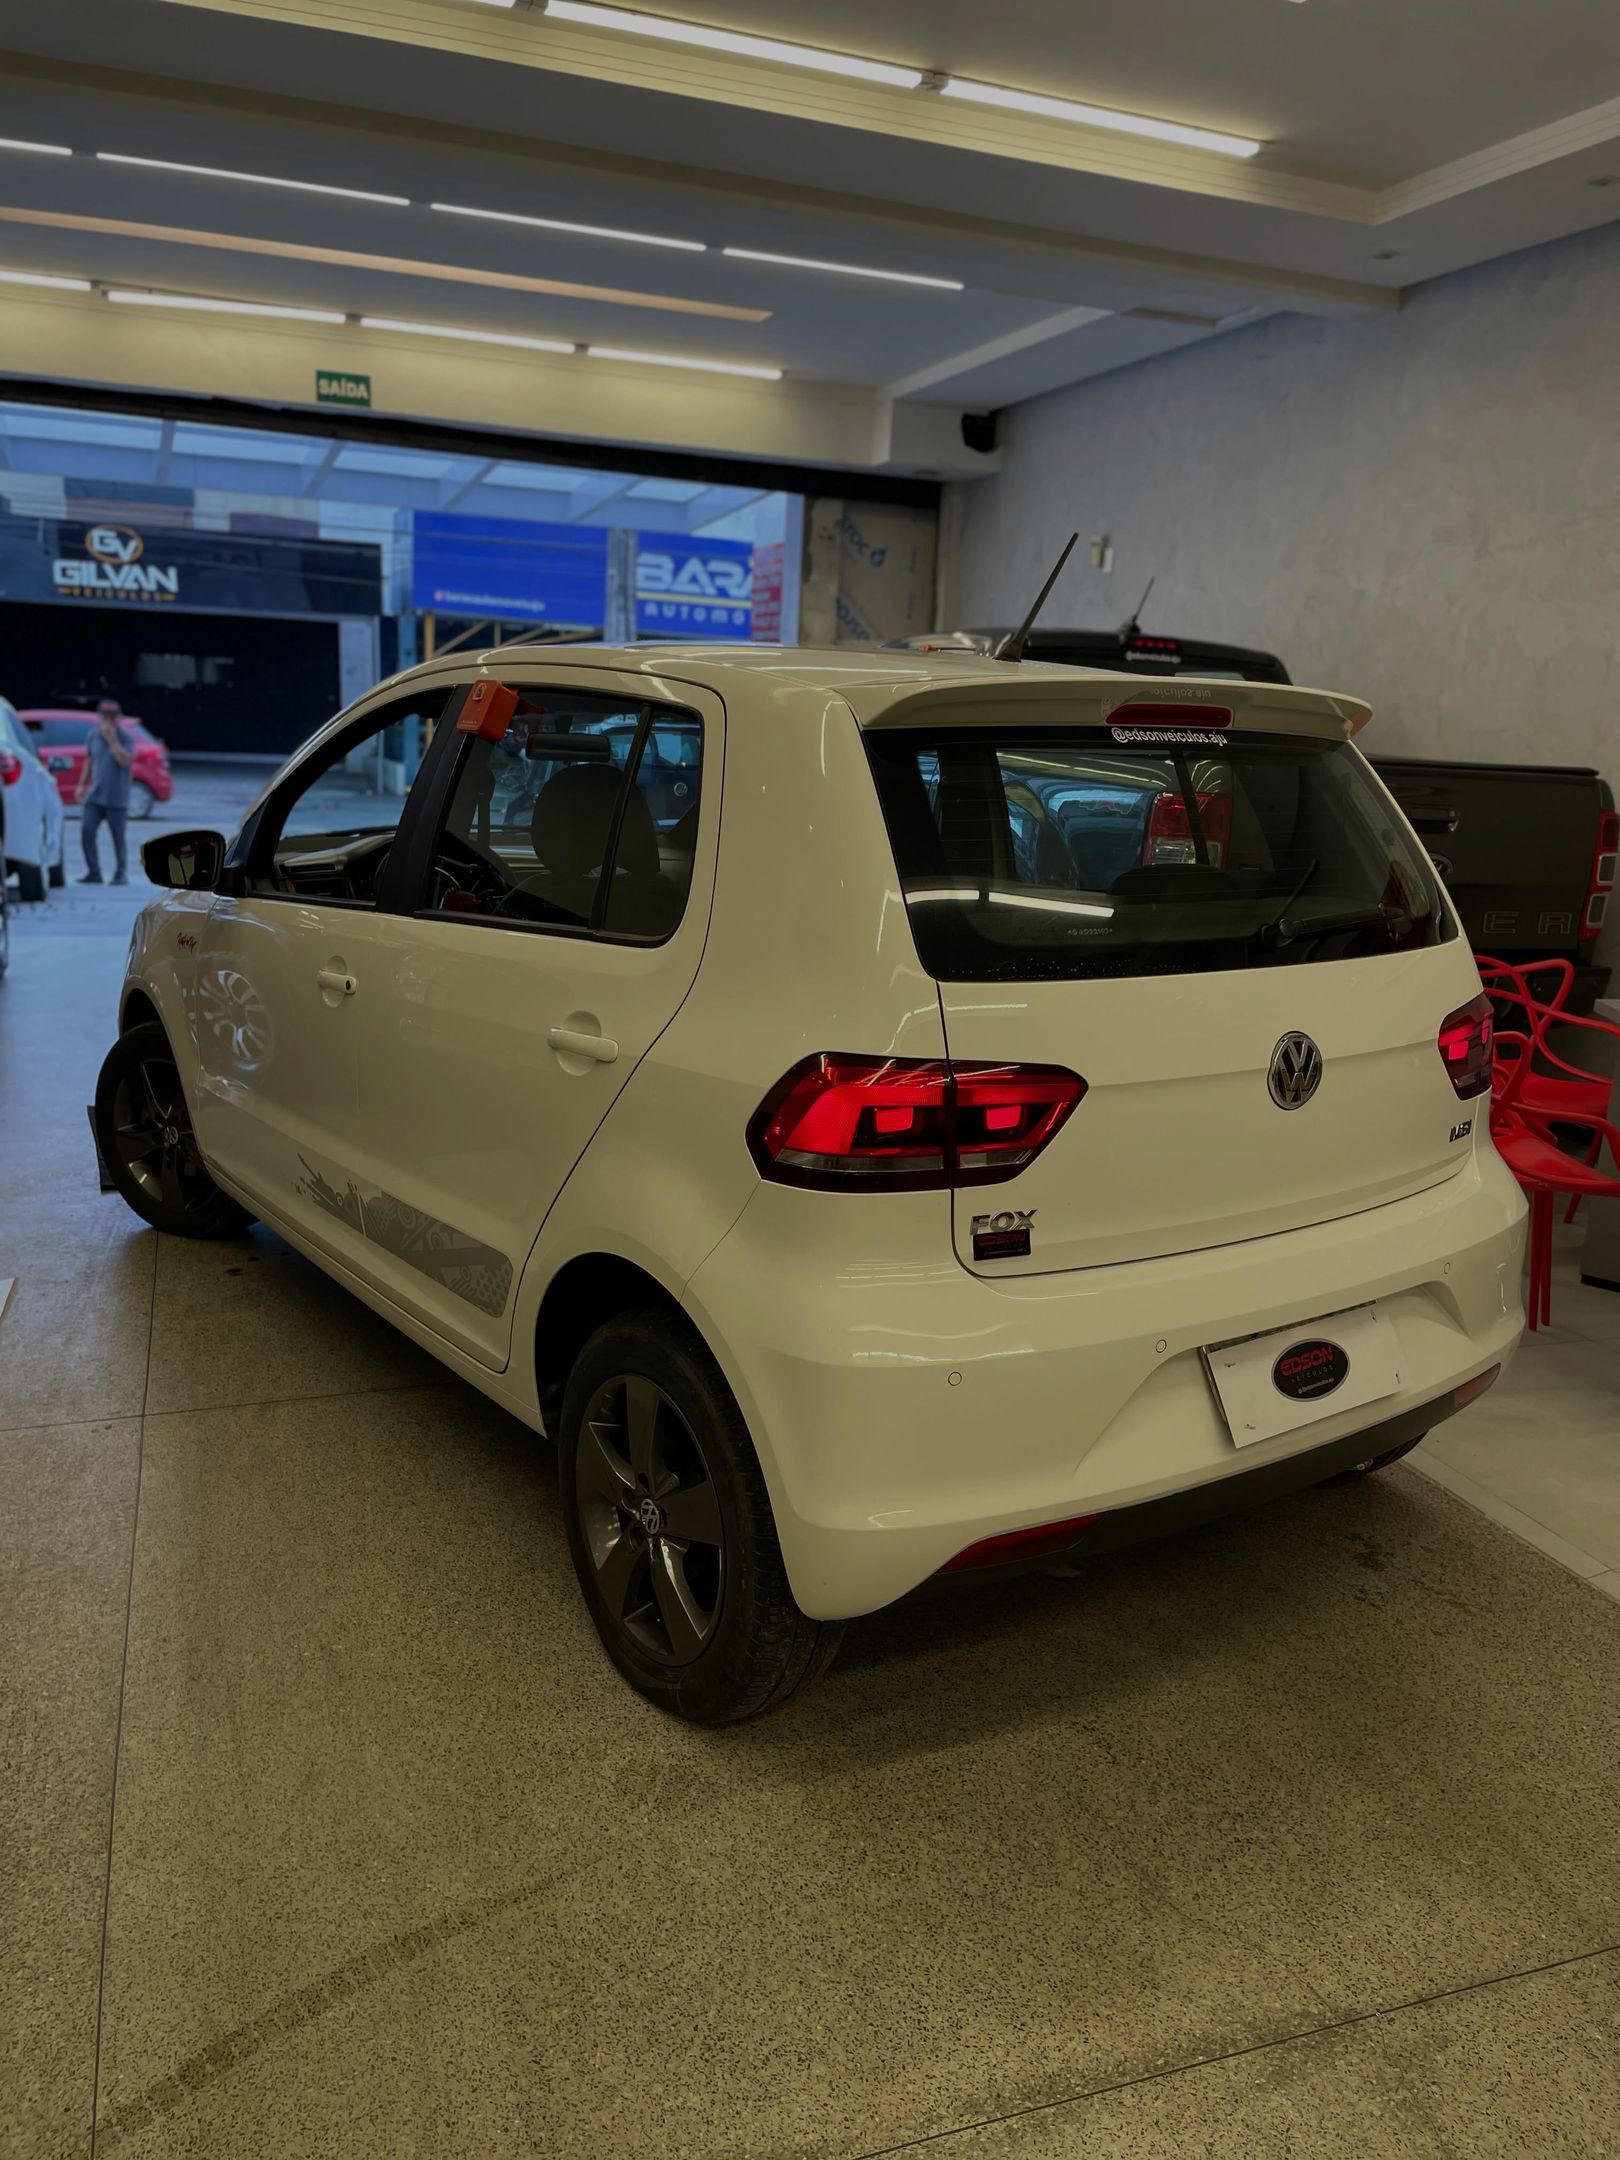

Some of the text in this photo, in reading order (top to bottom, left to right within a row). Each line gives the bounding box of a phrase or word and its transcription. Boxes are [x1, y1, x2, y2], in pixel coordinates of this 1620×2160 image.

[319, 378, 369, 400] SAÍDA
[91, 528, 138, 562] GV
[53, 559, 179, 593] GILVAN
[644, 602, 747, 626] AUTOMO
[1111, 727, 1228, 747] @edsonveiculos.aju
[970, 1209, 1038, 1236] FOX
[1280, 1345, 1335, 1377] EDSON
